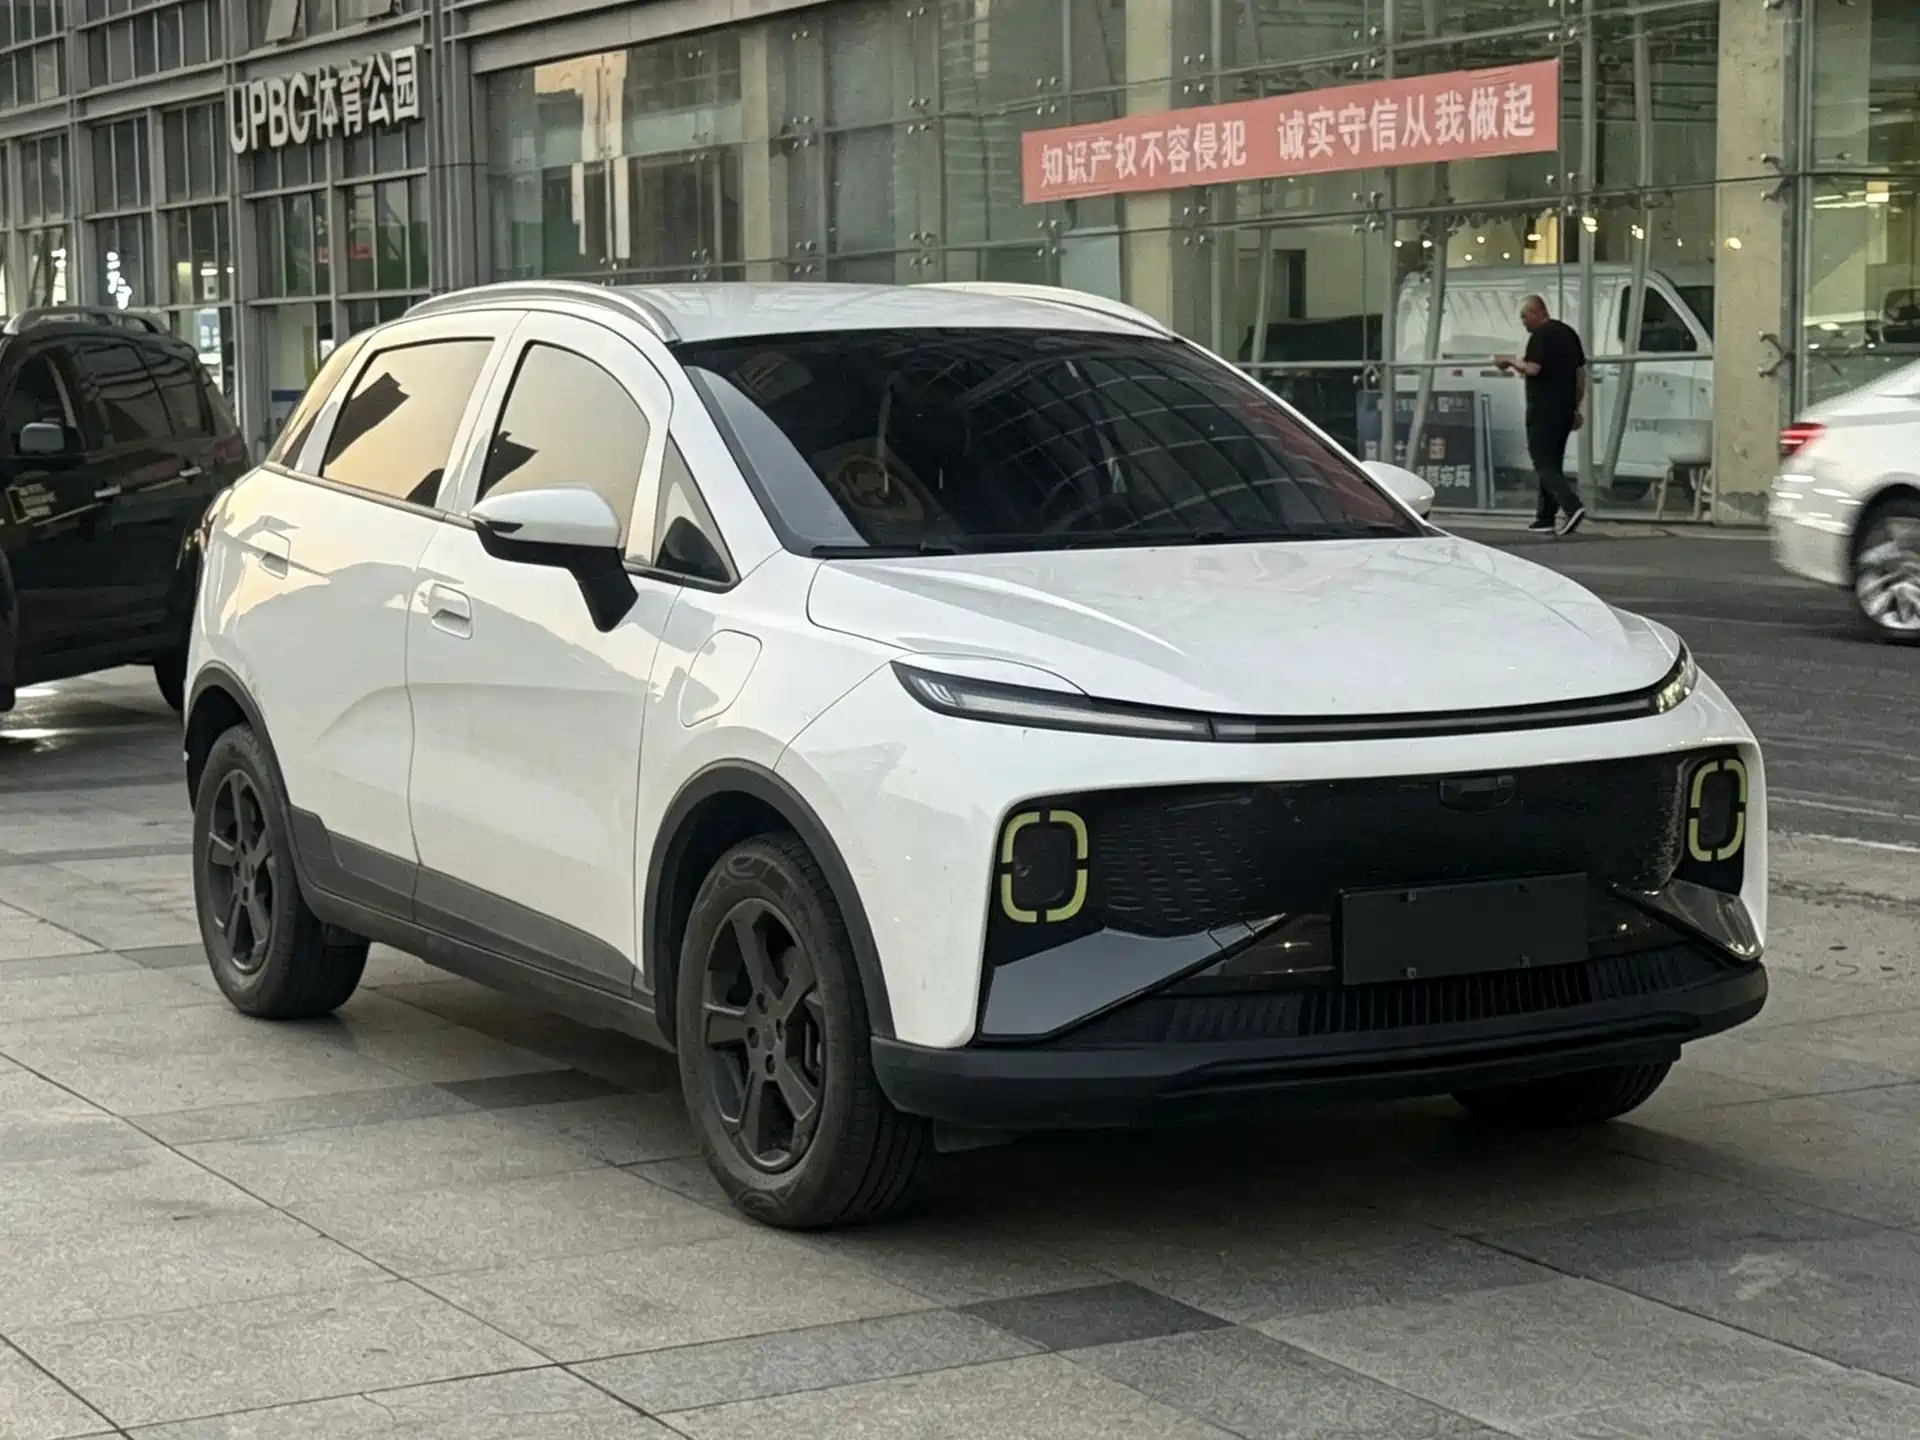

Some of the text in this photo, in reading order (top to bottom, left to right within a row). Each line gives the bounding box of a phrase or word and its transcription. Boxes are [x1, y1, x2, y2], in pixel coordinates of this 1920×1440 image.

[1040, 83, 1536, 188] 知识产权不容侵犯 诚实守信从我做起
